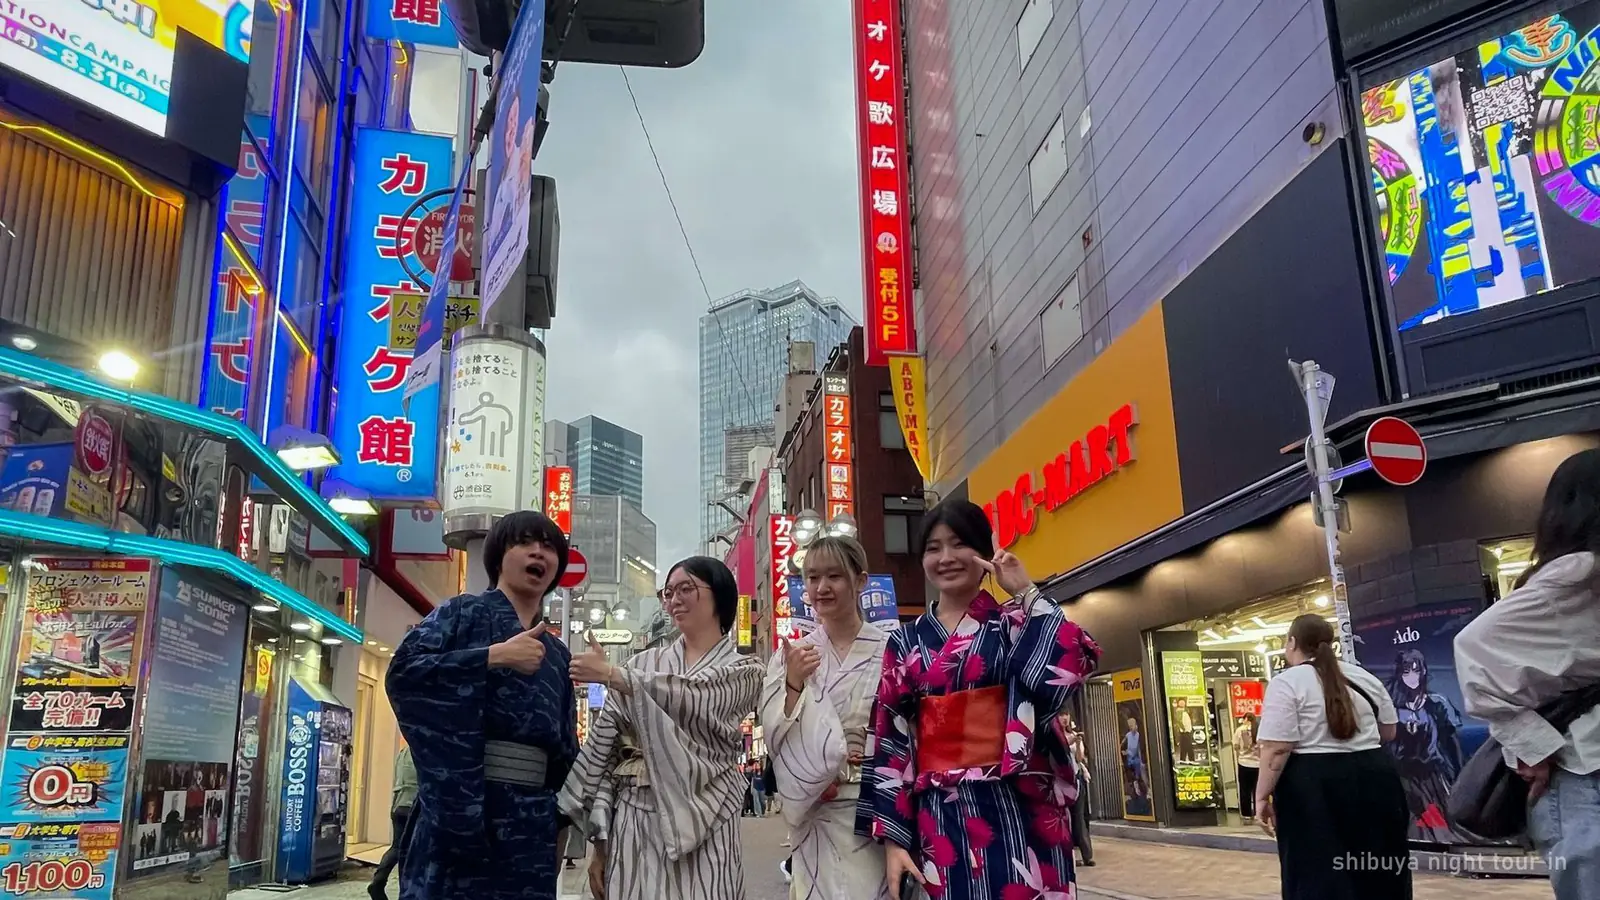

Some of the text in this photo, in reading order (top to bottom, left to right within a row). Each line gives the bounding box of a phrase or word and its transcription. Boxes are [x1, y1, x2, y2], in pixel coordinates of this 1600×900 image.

[422, 224, 475, 258] 消火
[196, 602, 230, 624] SONIC
[1393, 626, 1421, 645] Ado
[286, 746, 309, 797] BOSS
[293, 795, 304, 832] COFFEE
